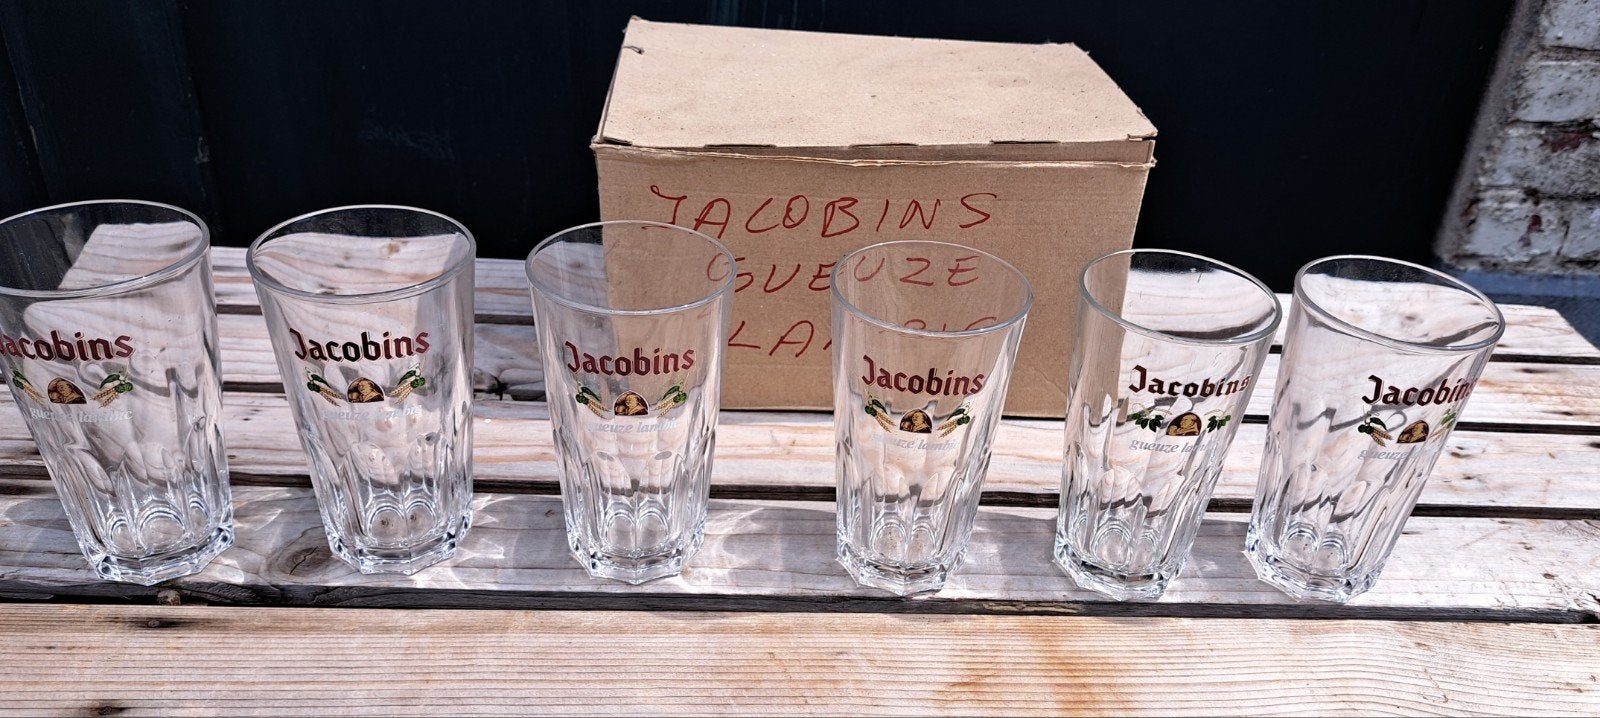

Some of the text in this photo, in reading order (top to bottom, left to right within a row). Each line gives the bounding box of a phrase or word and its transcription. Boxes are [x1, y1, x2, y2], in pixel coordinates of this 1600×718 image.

[642, 185, 998, 240] JACOBINS
[706, 252, 981, 294] GUEUZE
[289, 327, 430, 362] Jacobins
[565, 340, 695, 376] Jacobins
[861, 354, 985, 396] Jacobins
[1128, 364, 1251, 398] Jacobins
[1129, 439, 1179, 453] gueuze
